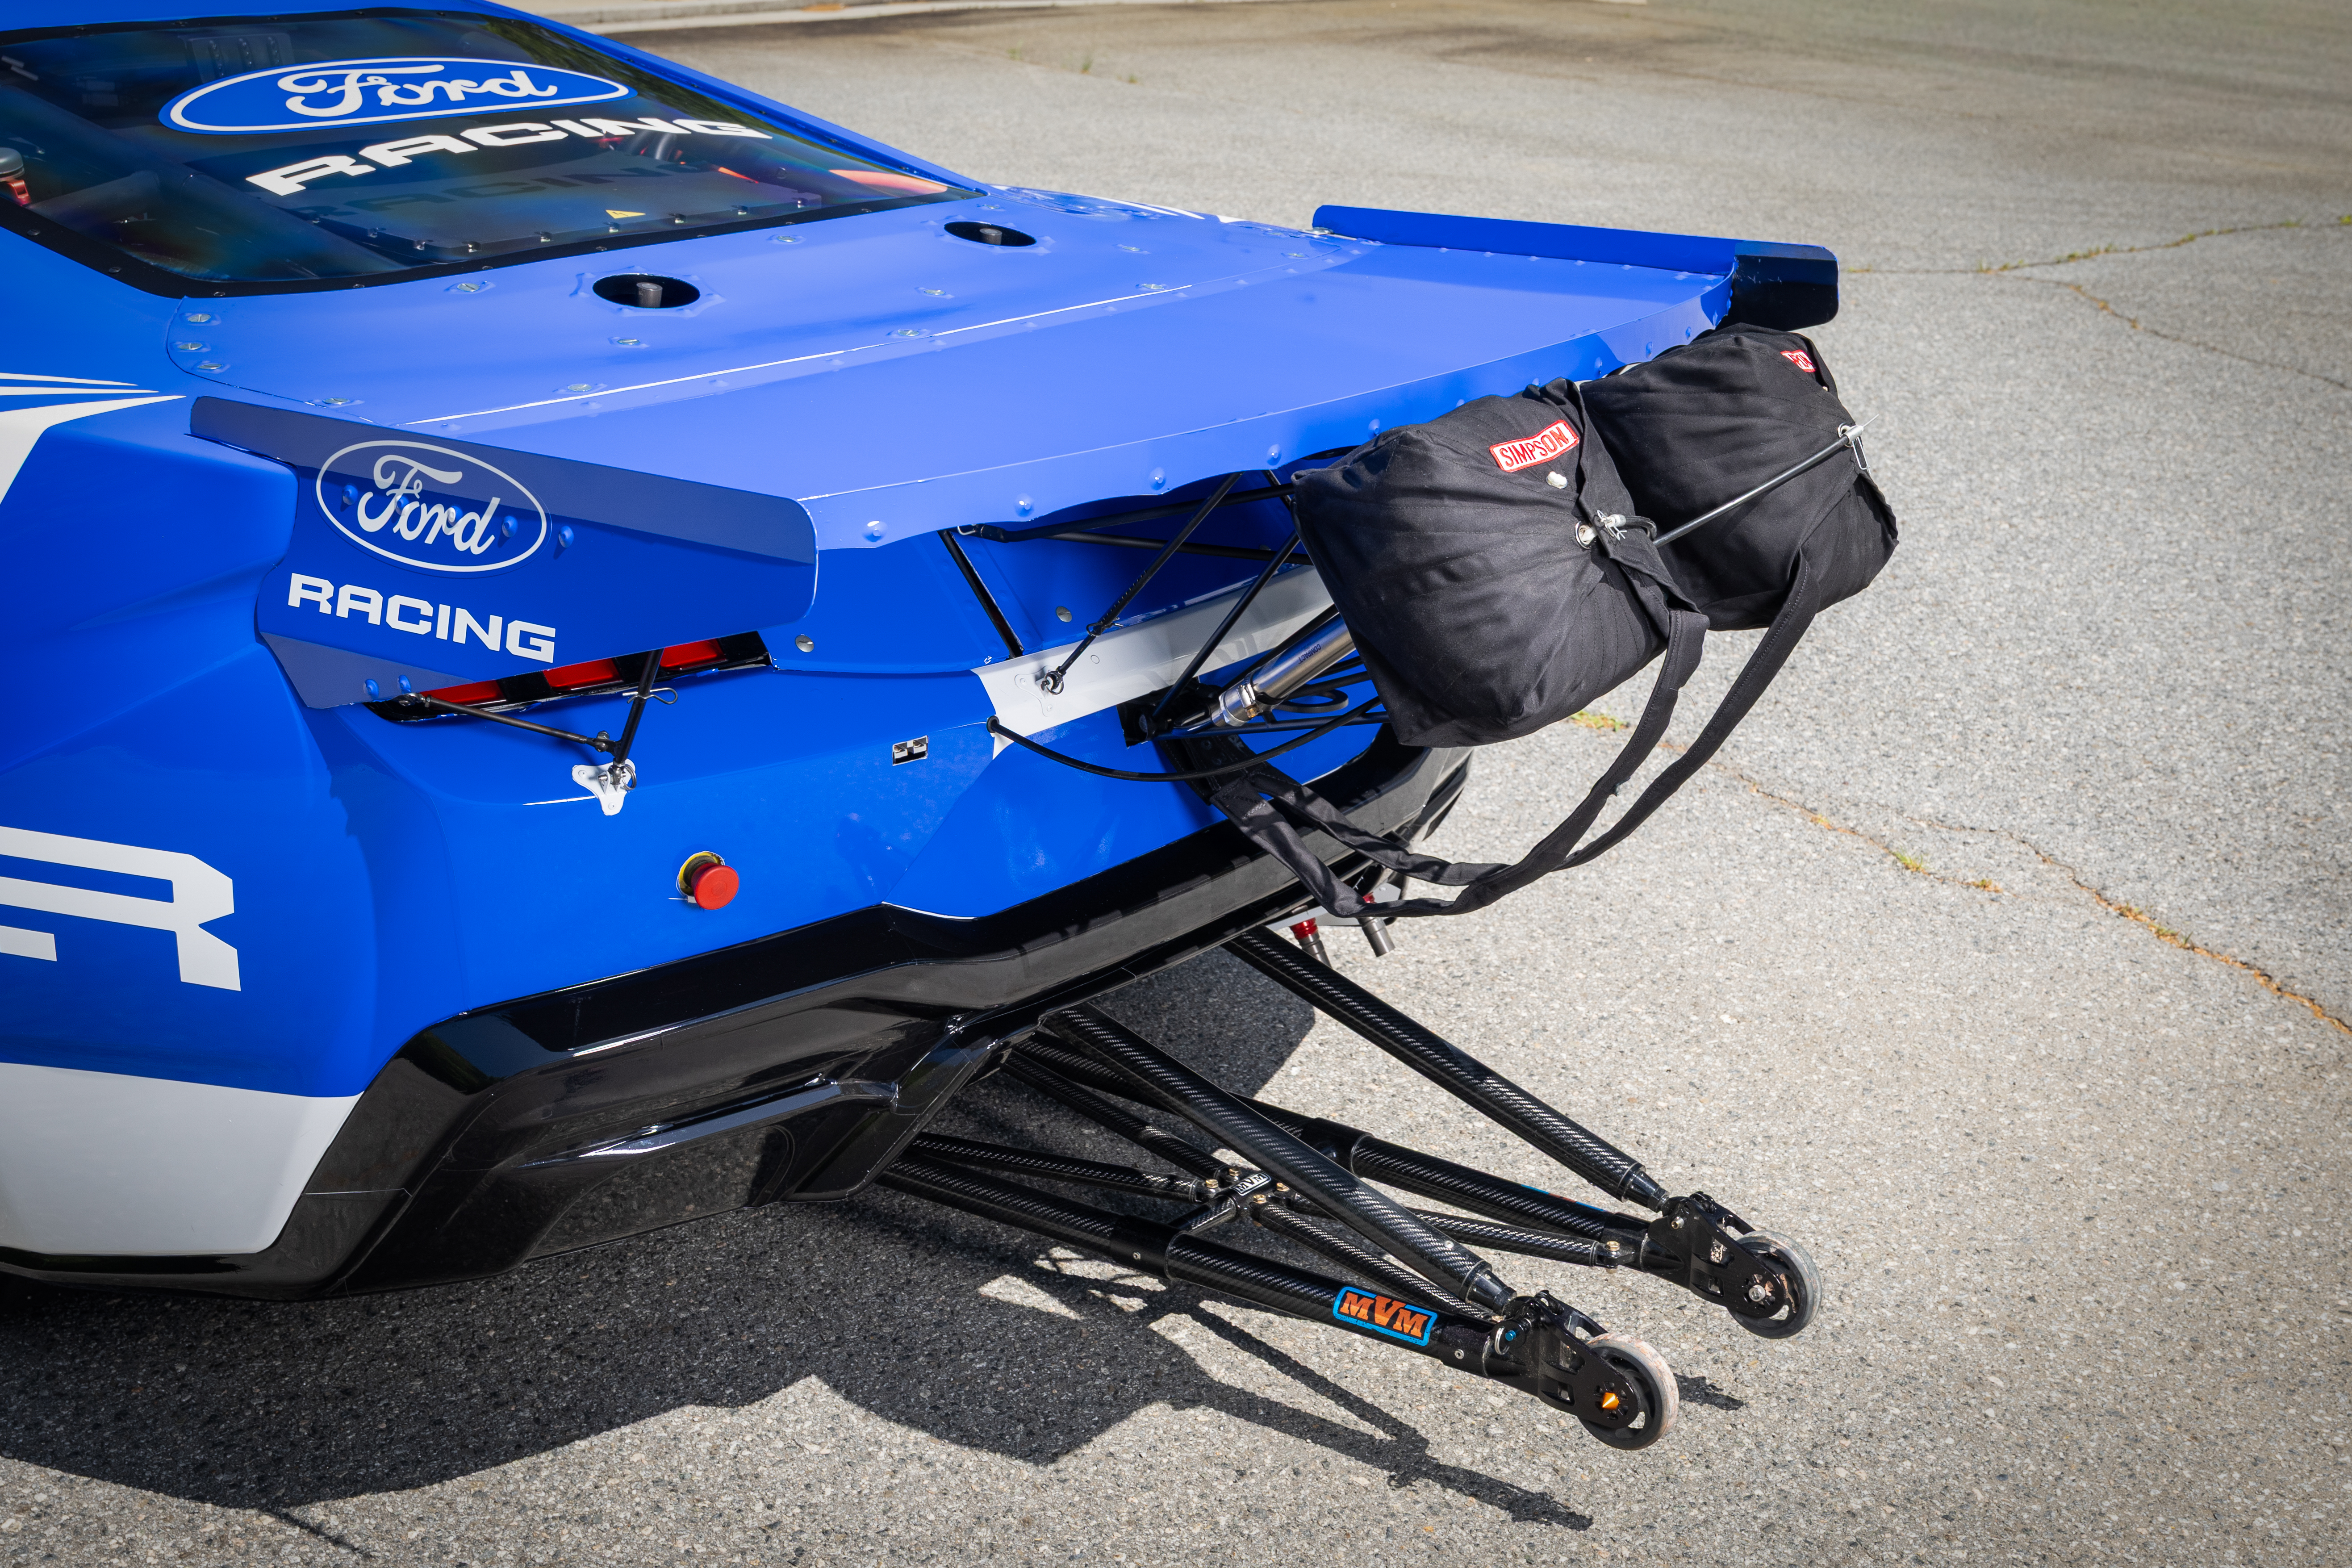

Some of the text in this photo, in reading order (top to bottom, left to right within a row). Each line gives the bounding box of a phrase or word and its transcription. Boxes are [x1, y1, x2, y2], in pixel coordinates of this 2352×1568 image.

[278, 65, 557, 117] Ford
[246, 118, 773, 196] RACING
[1499, 426, 1569, 467] SIMPSON
[358, 455, 500, 554] Ford
[288, 573, 556, 663] RACING
[1299, 644, 1321, 664] COMPACT
[1236, 1173, 1267, 1192] MVM
[1340, 1292, 1428, 1338] MVM
